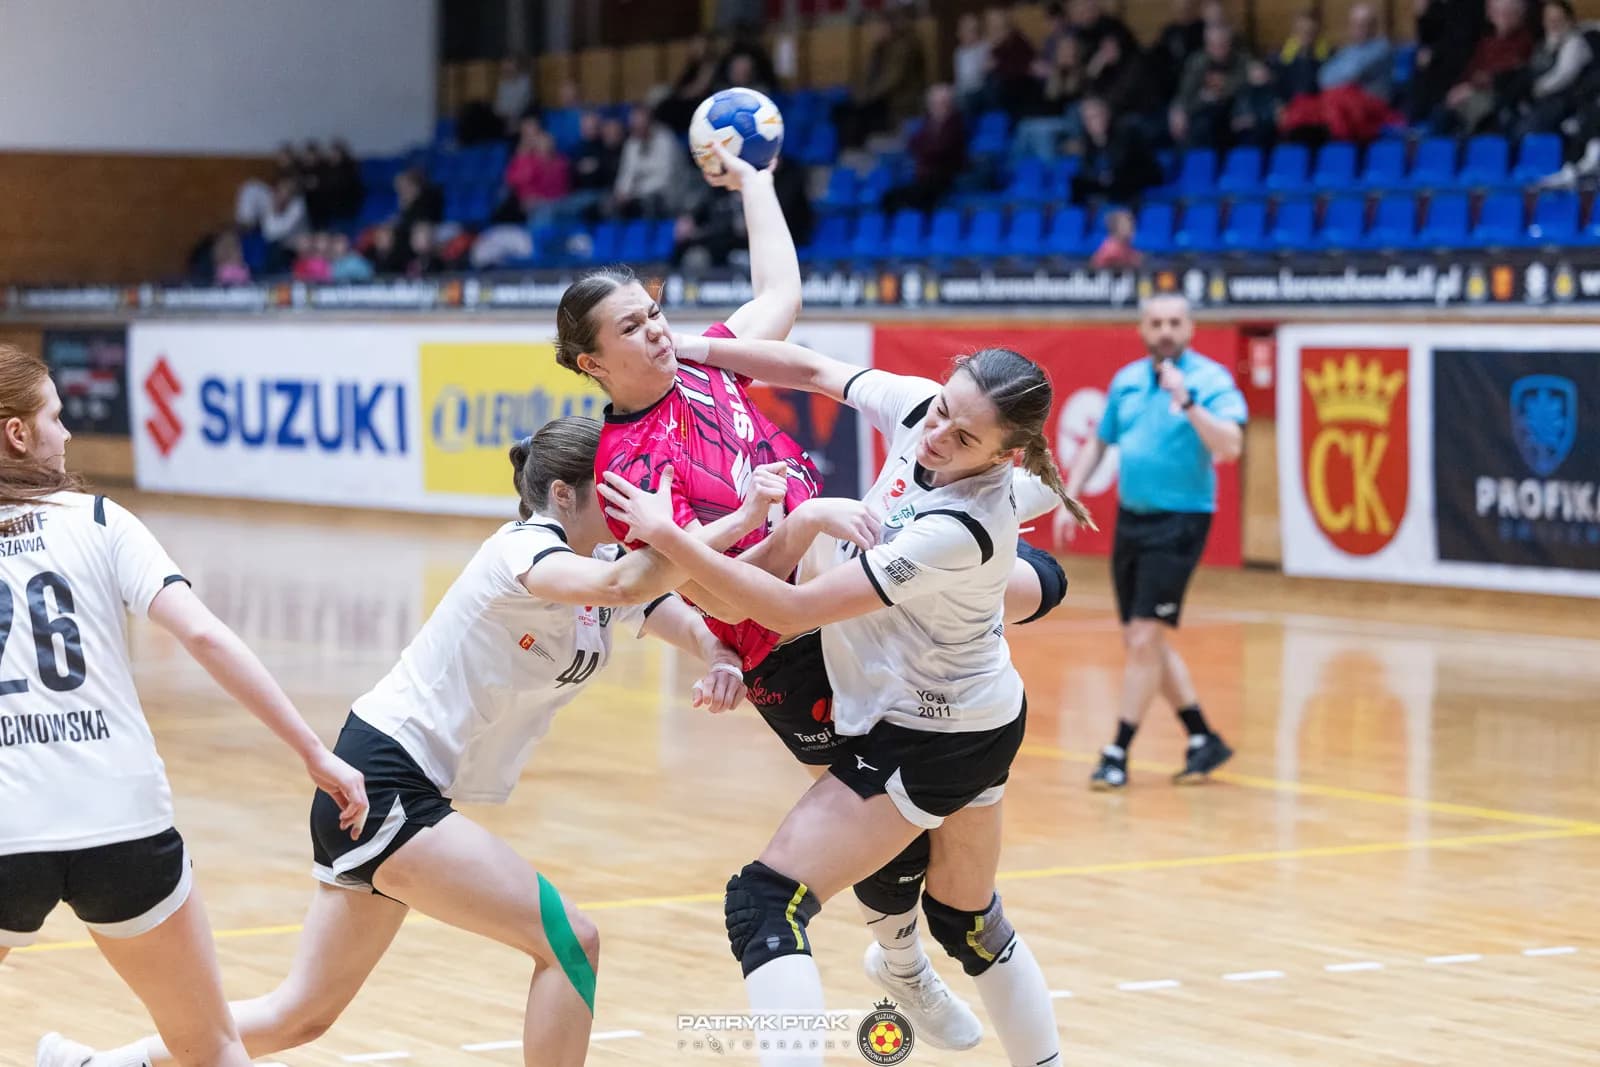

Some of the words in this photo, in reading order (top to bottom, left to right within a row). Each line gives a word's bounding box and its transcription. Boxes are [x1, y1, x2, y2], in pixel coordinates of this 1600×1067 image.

[200, 376, 409, 457] SUZUKI
[1308, 428, 1394, 535] CK
[1475, 475, 1600, 525] PROFIK
[0, 571, 86, 695] 26
[0, 709, 111, 747] CIKOWSKA
[793, 727, 832, 743] Targi
[918, 705, 951, 718] 2011
